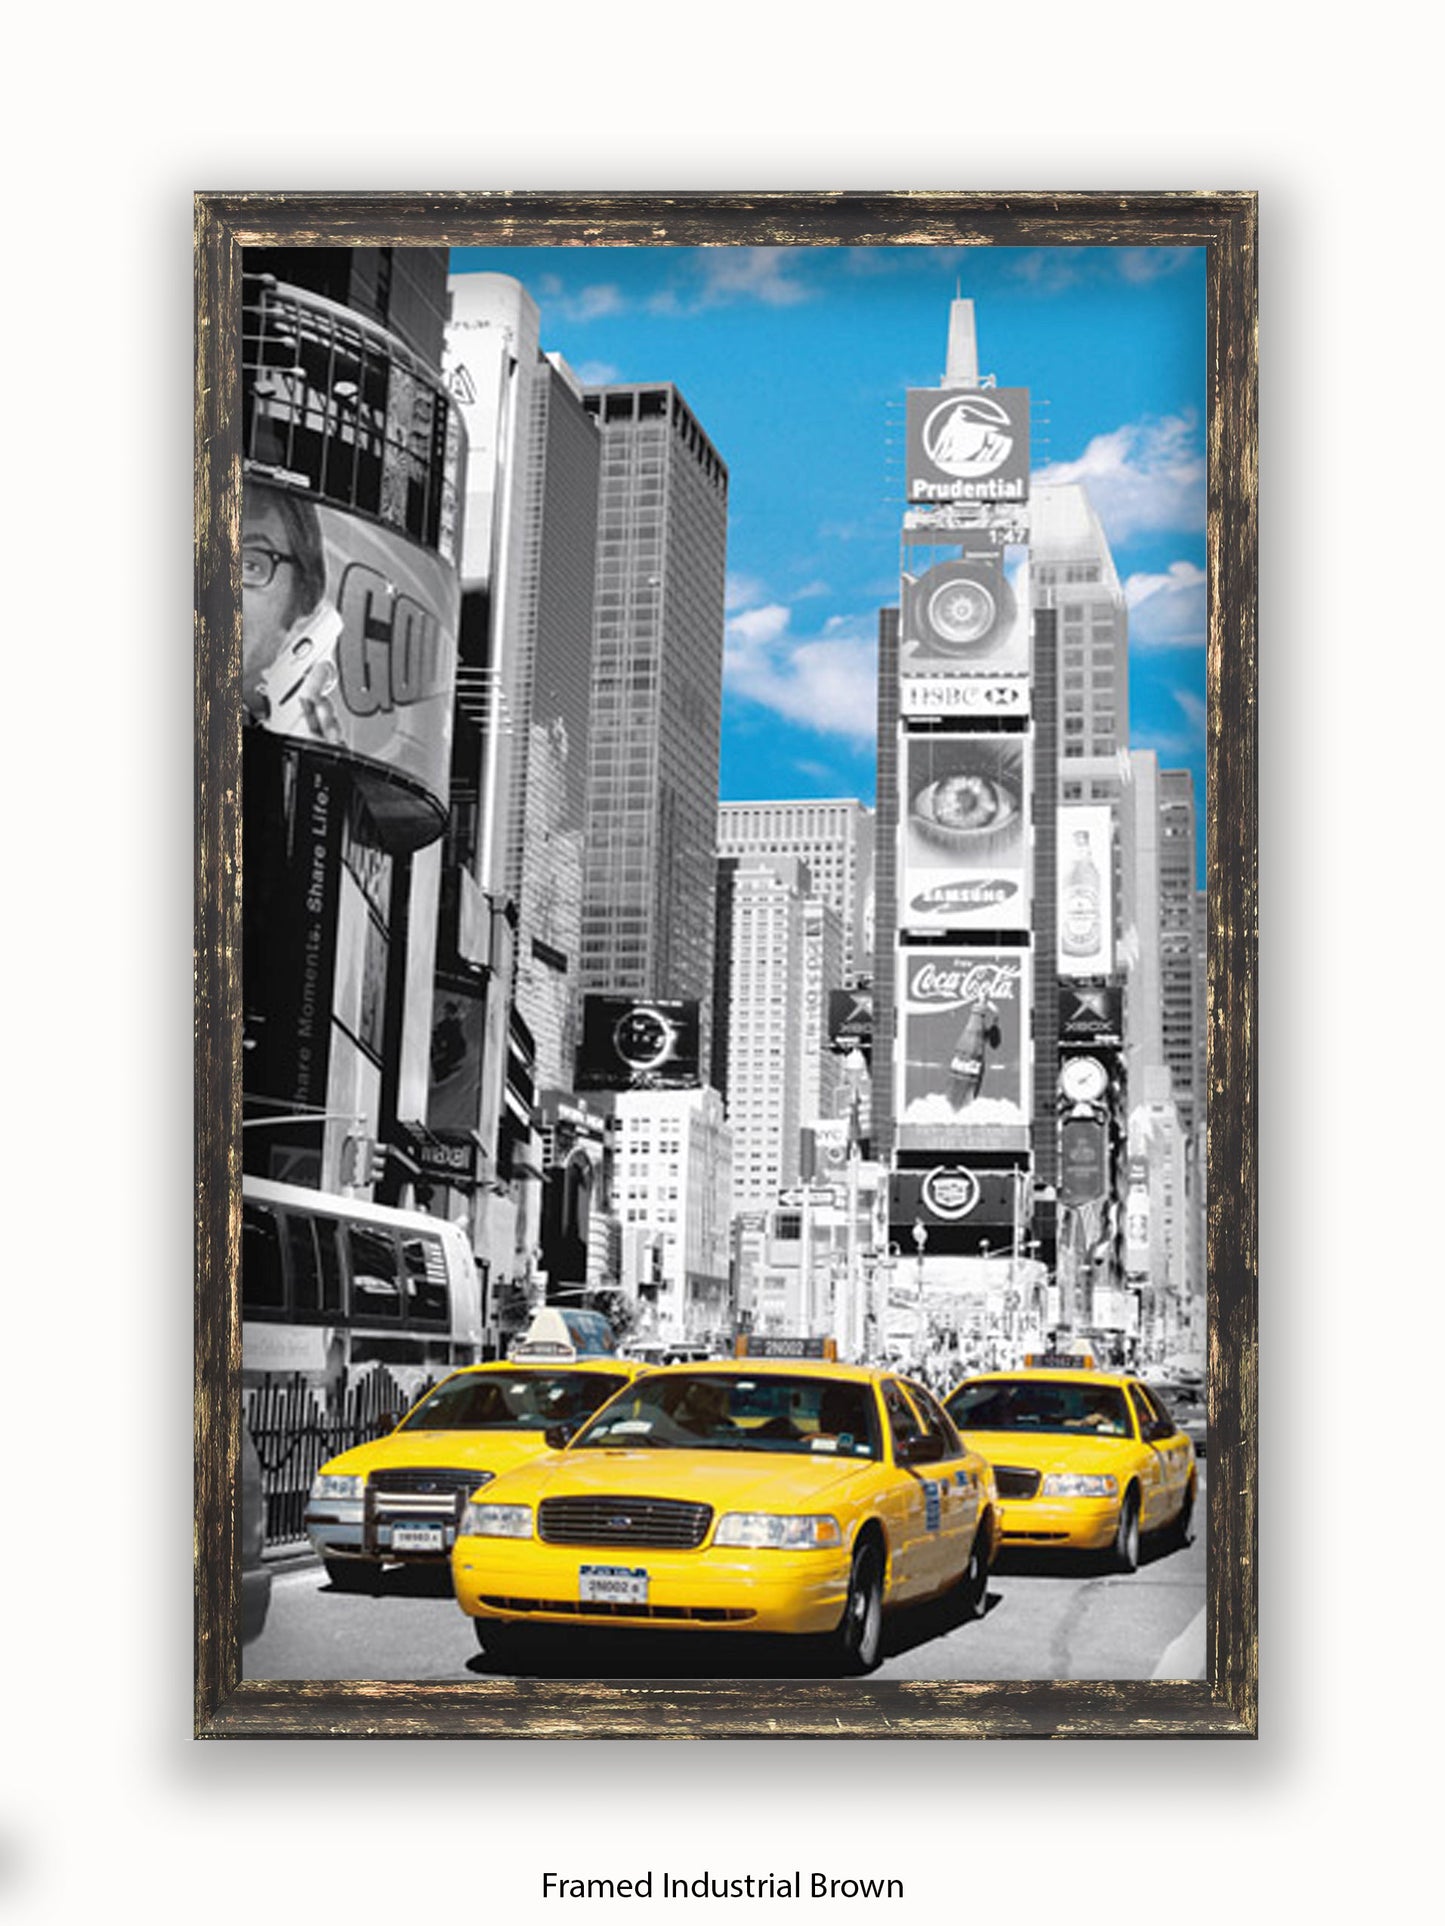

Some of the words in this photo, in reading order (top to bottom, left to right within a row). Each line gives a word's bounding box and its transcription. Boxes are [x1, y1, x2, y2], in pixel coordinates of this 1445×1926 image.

[912, 478, 1023, 499] Prudential
[910, 686, 980, 706] HSBC
[306, 845, 327, 913] Share
[922, 888, 1006, 902] SAMSUNG
[1064, 1021, 1113, 1032] XBOX
